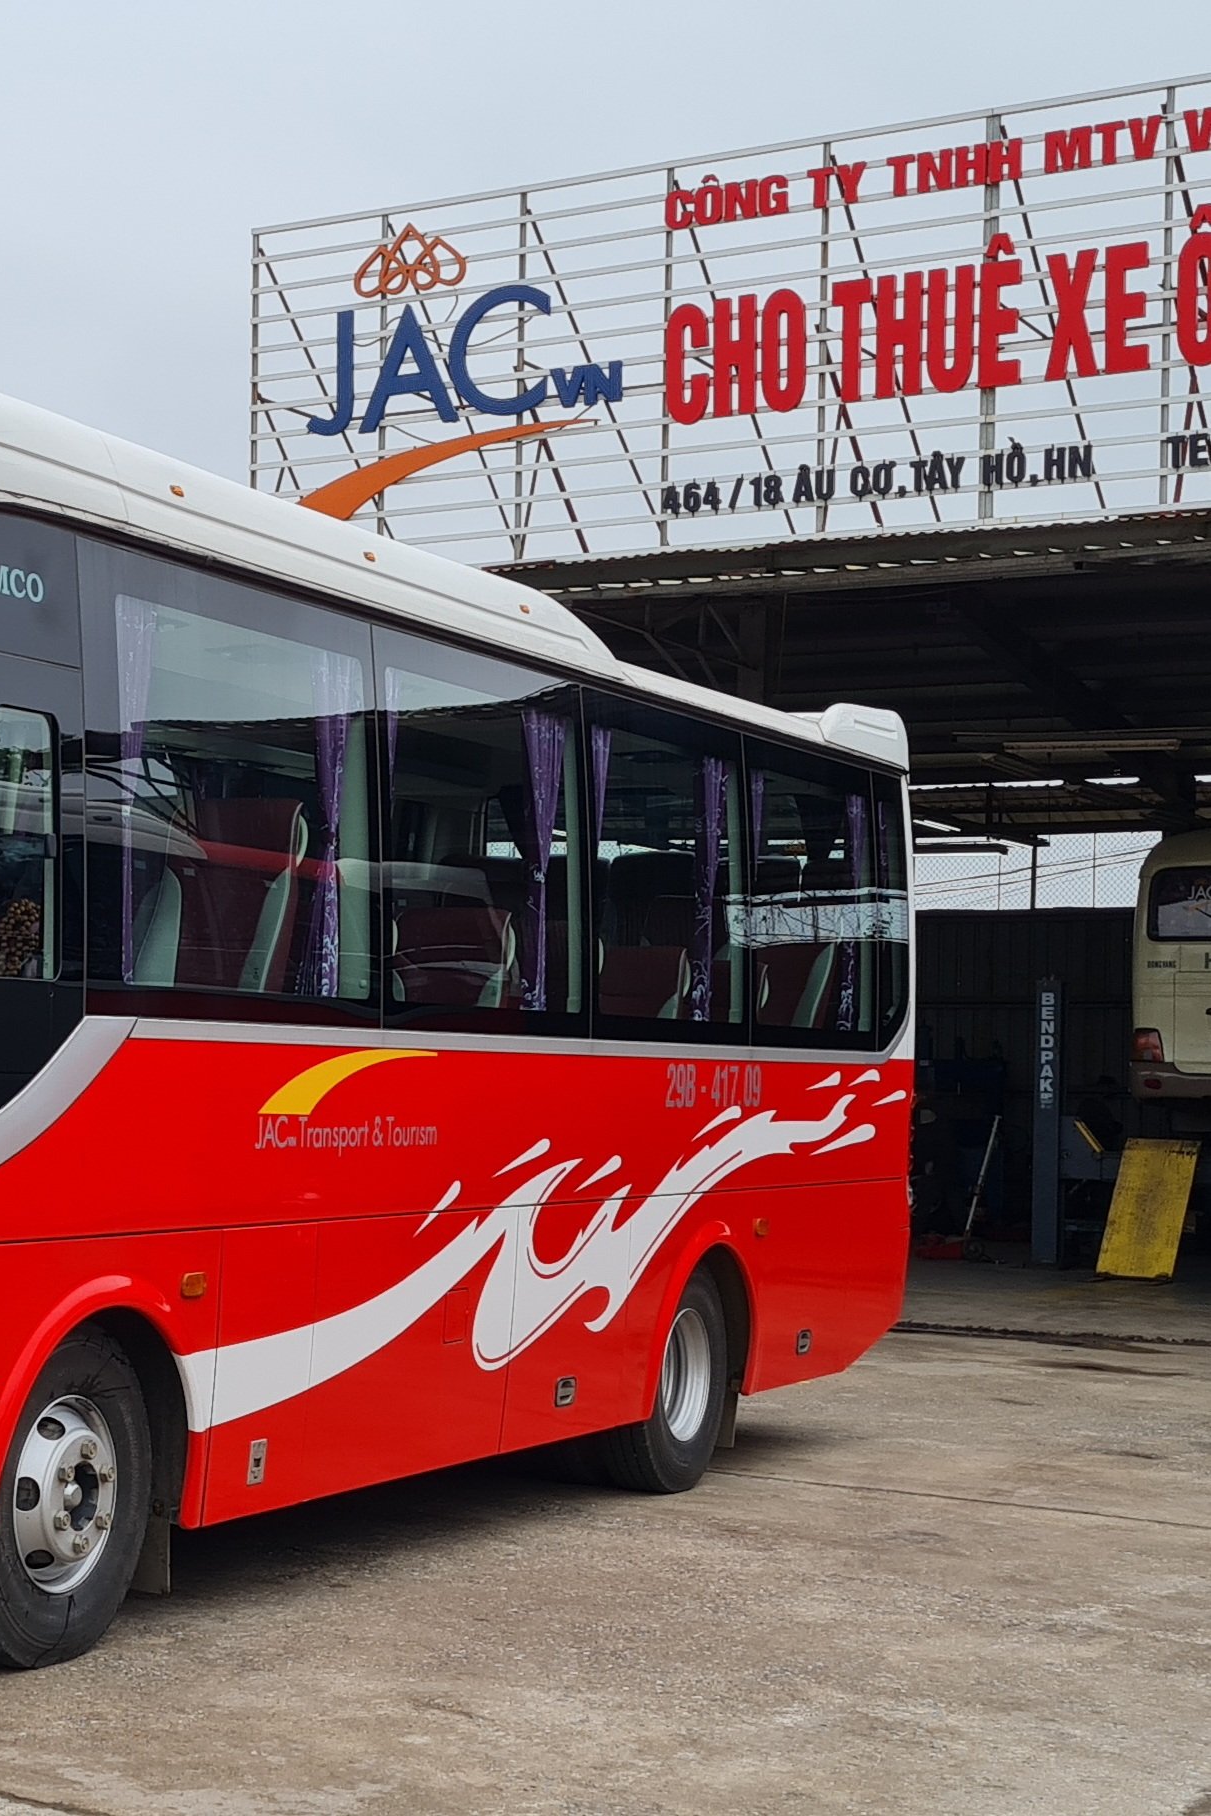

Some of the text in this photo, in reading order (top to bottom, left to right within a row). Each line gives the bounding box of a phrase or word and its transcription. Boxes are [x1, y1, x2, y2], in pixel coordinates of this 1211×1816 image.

[665, 174, 789, 230] CÔNG
[807, 161, 868, 208] TY
[887, 138, 1023, 196] TNHH
[1045, 115, 1162, 173] MTV
[307, 285, 623, 436] JAC VN
[665, 288, 807, 425] CHO
[832, 233, 1023, 403] THUÊ
[1045, 241, 1150, 381] XE
[792, 464, 836, 503] ÂU
[665, 1063, 696, 1108] 29B
[711, 1064, 762, 1108] 417.09
[1040, 992, 1055, 1092] BENDPAK
[255, 1116, 289, 1149] JAC
[299, 1116, 369, 1157] Transport
[372, 1116, 383, 1147] &
[386, 1116, 438, 1146] Tourism
